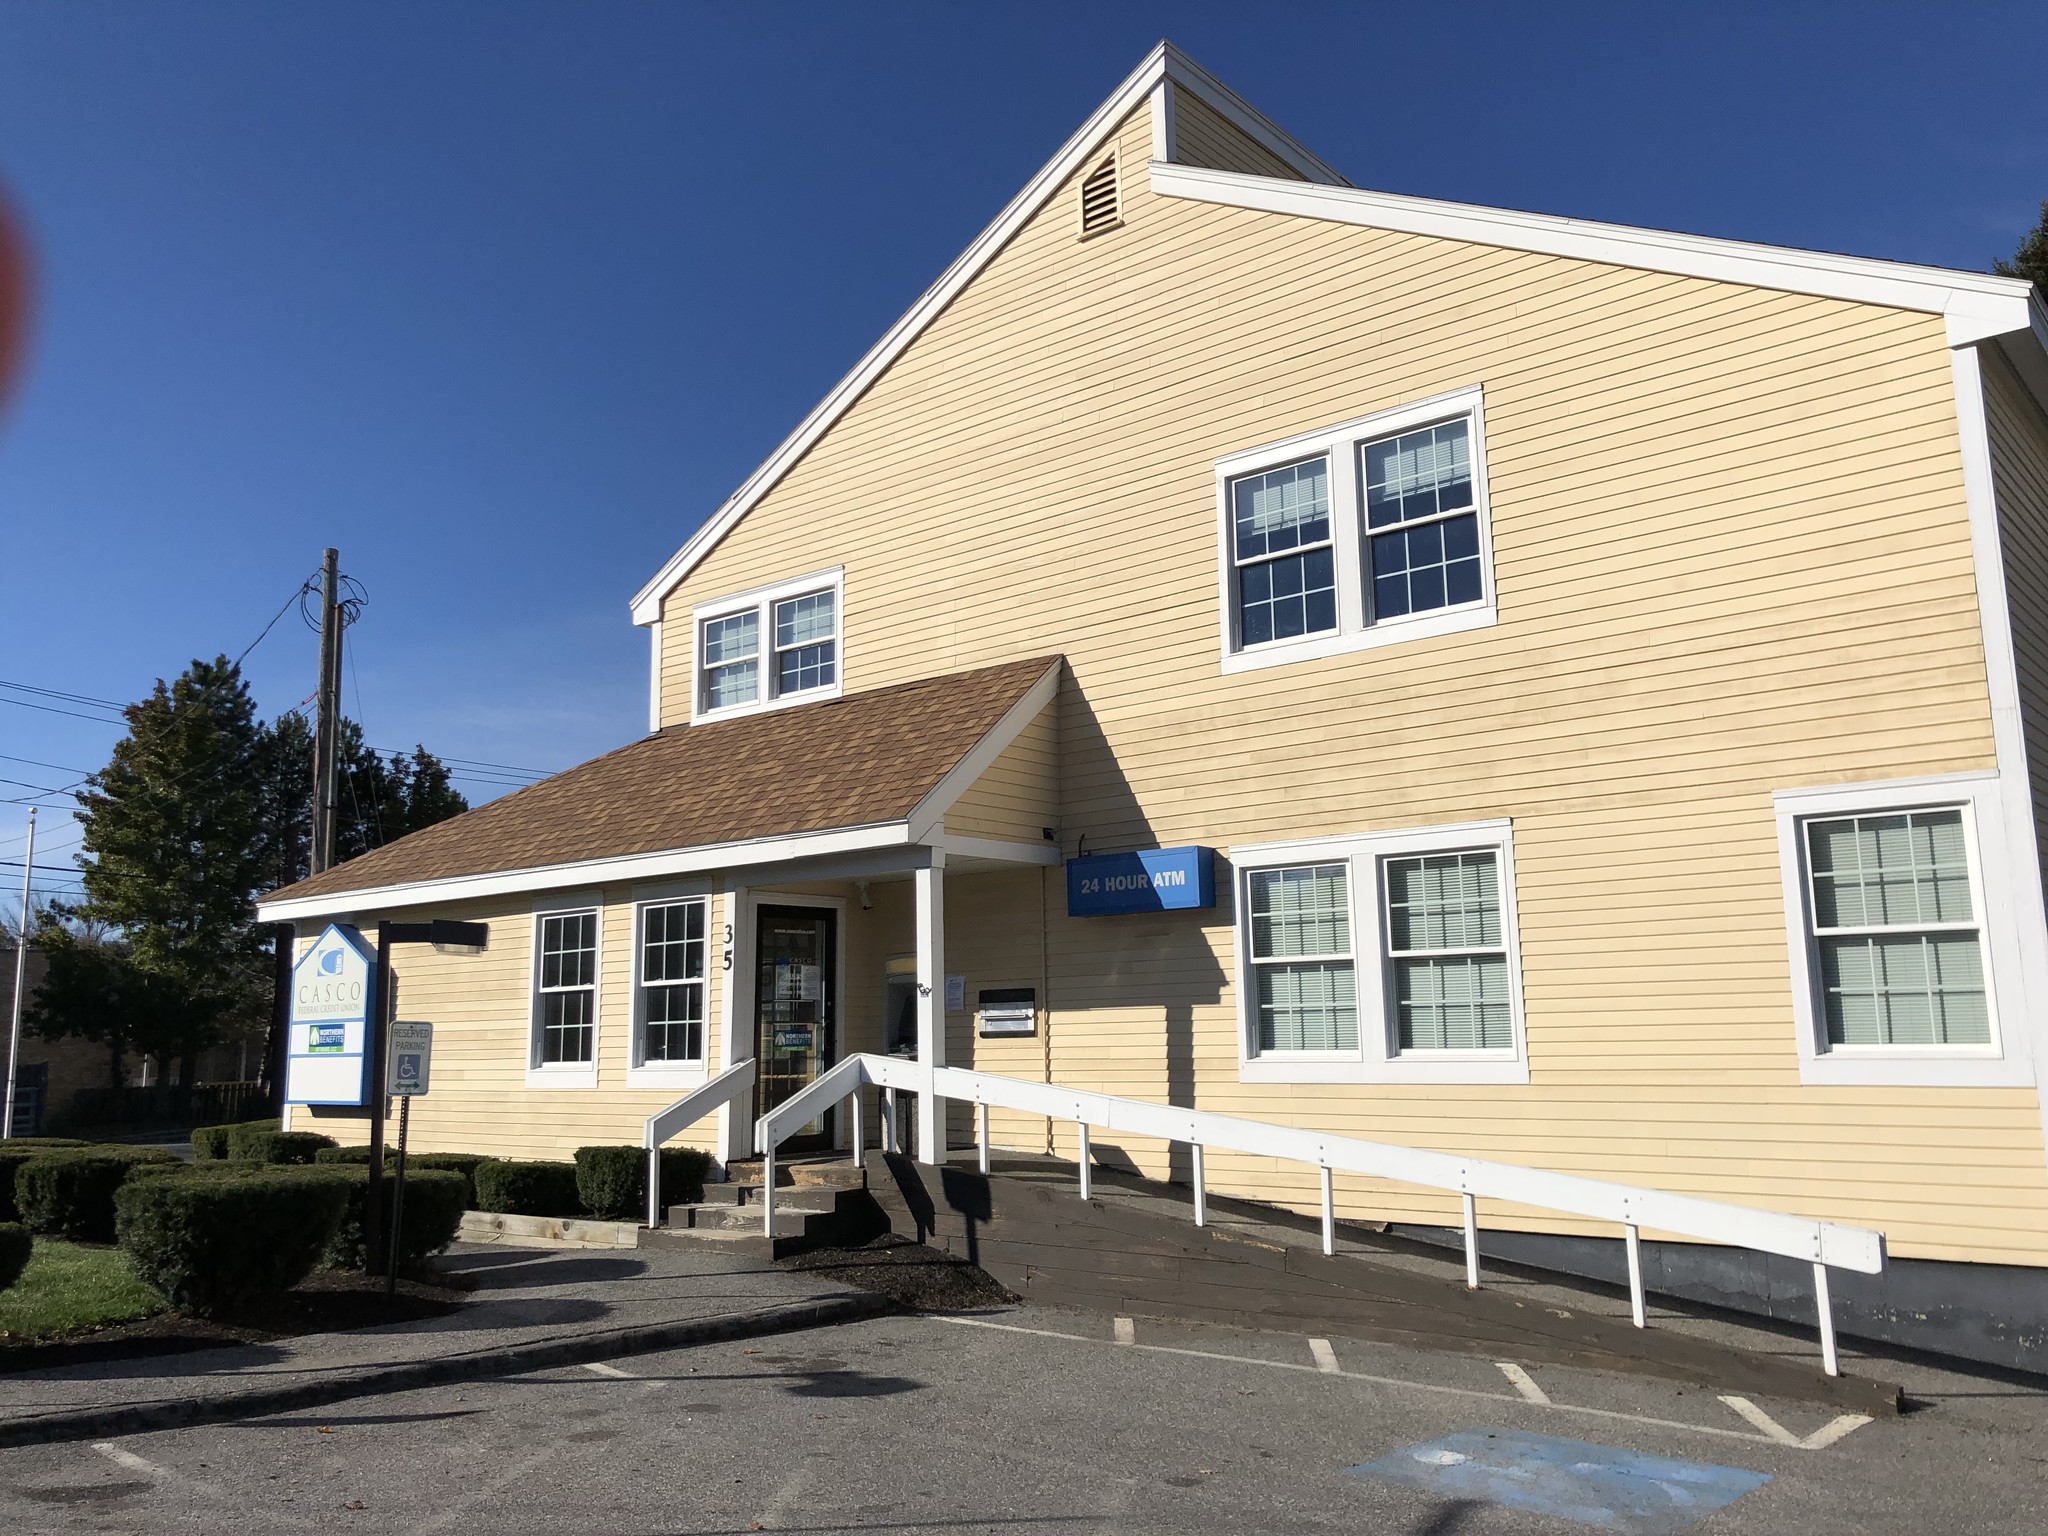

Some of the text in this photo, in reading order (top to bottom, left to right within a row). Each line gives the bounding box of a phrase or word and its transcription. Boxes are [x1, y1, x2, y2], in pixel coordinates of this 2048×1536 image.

[1081, 870, 1186, 894] 24 HOUR ATM
[299, 981, 361, 1004] CASCO
[340, 1003, 360, 1012] UNION
[394, 1028, 430, 1038] RESERVED
[319, 1035, 345, 1044] BENEFITS
[395, 1041, 426, 1051] PARKING
